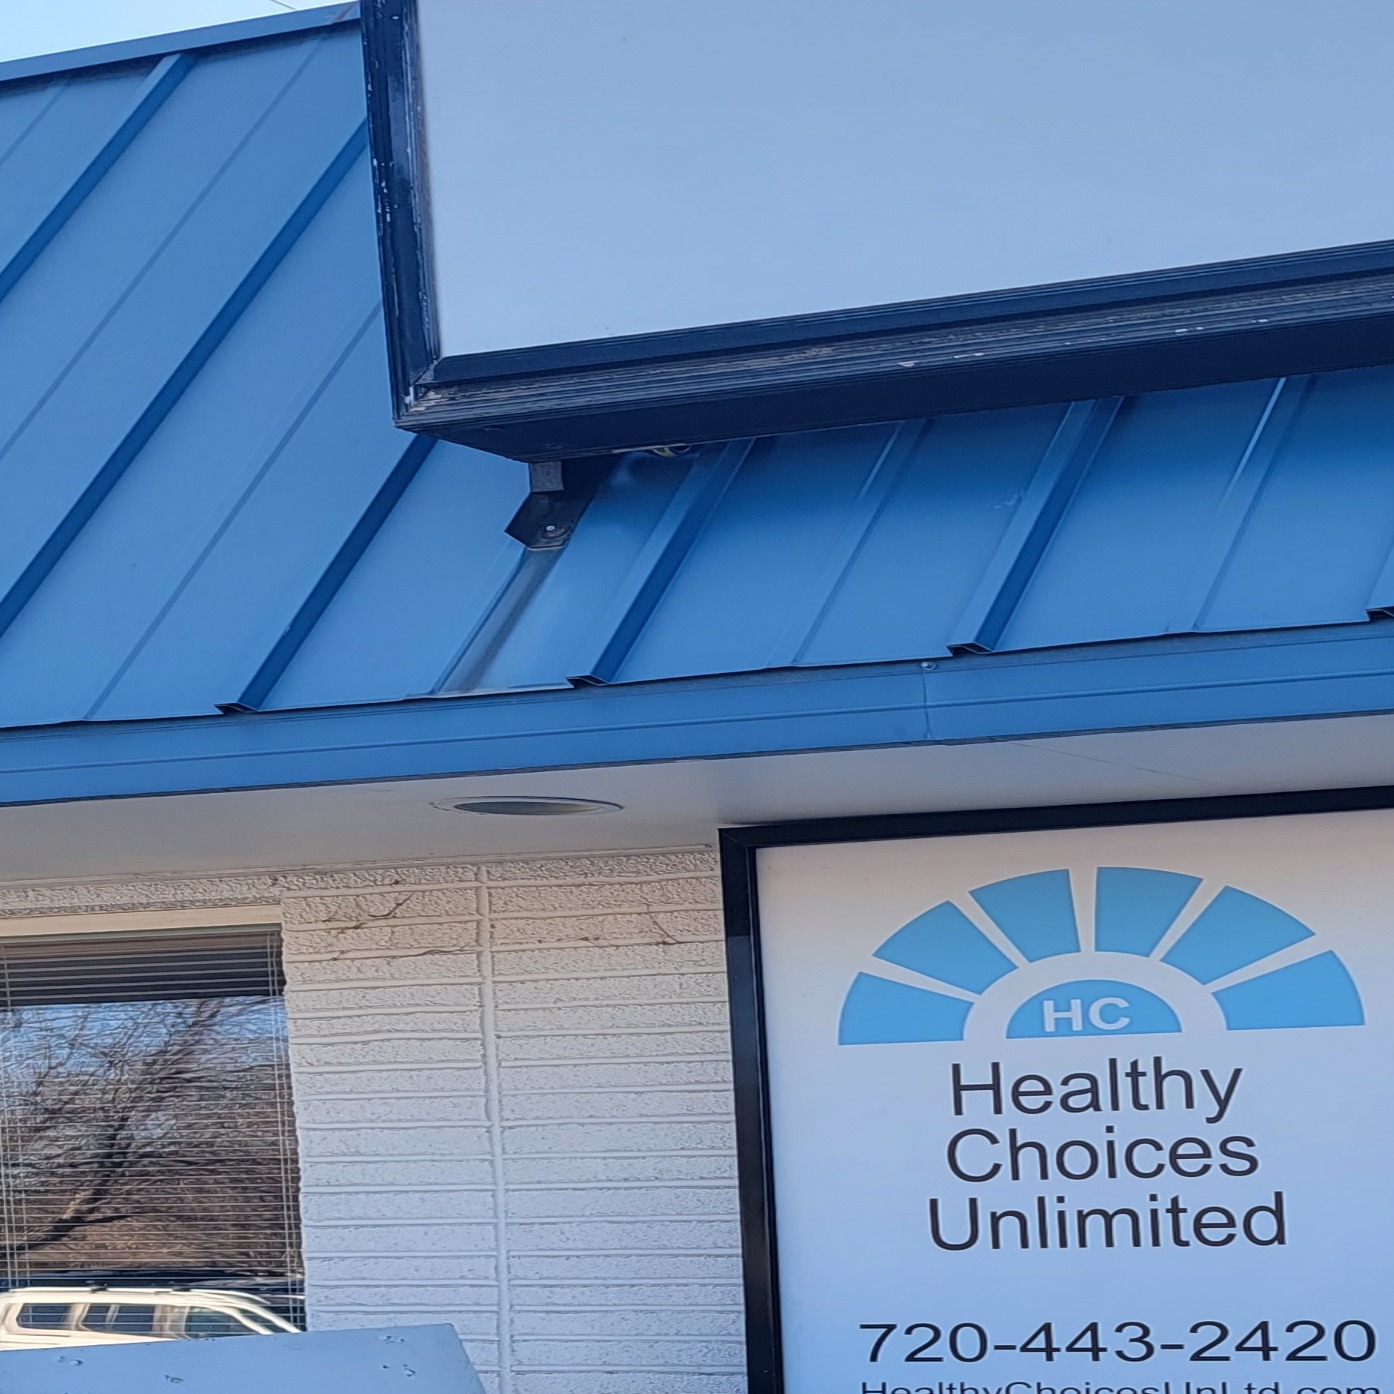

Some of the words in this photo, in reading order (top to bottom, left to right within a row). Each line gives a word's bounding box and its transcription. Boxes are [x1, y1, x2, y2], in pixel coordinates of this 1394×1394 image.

[1041, 996, 1132, 1033] HC
[950, 1056, 1244, 1124] Healthy
[946, 1126, 1260, 1183] Choices
[928, 1192, 1288, 1250] Unlimited
[859, 1319, 1377, 1364] 720-443-2420
